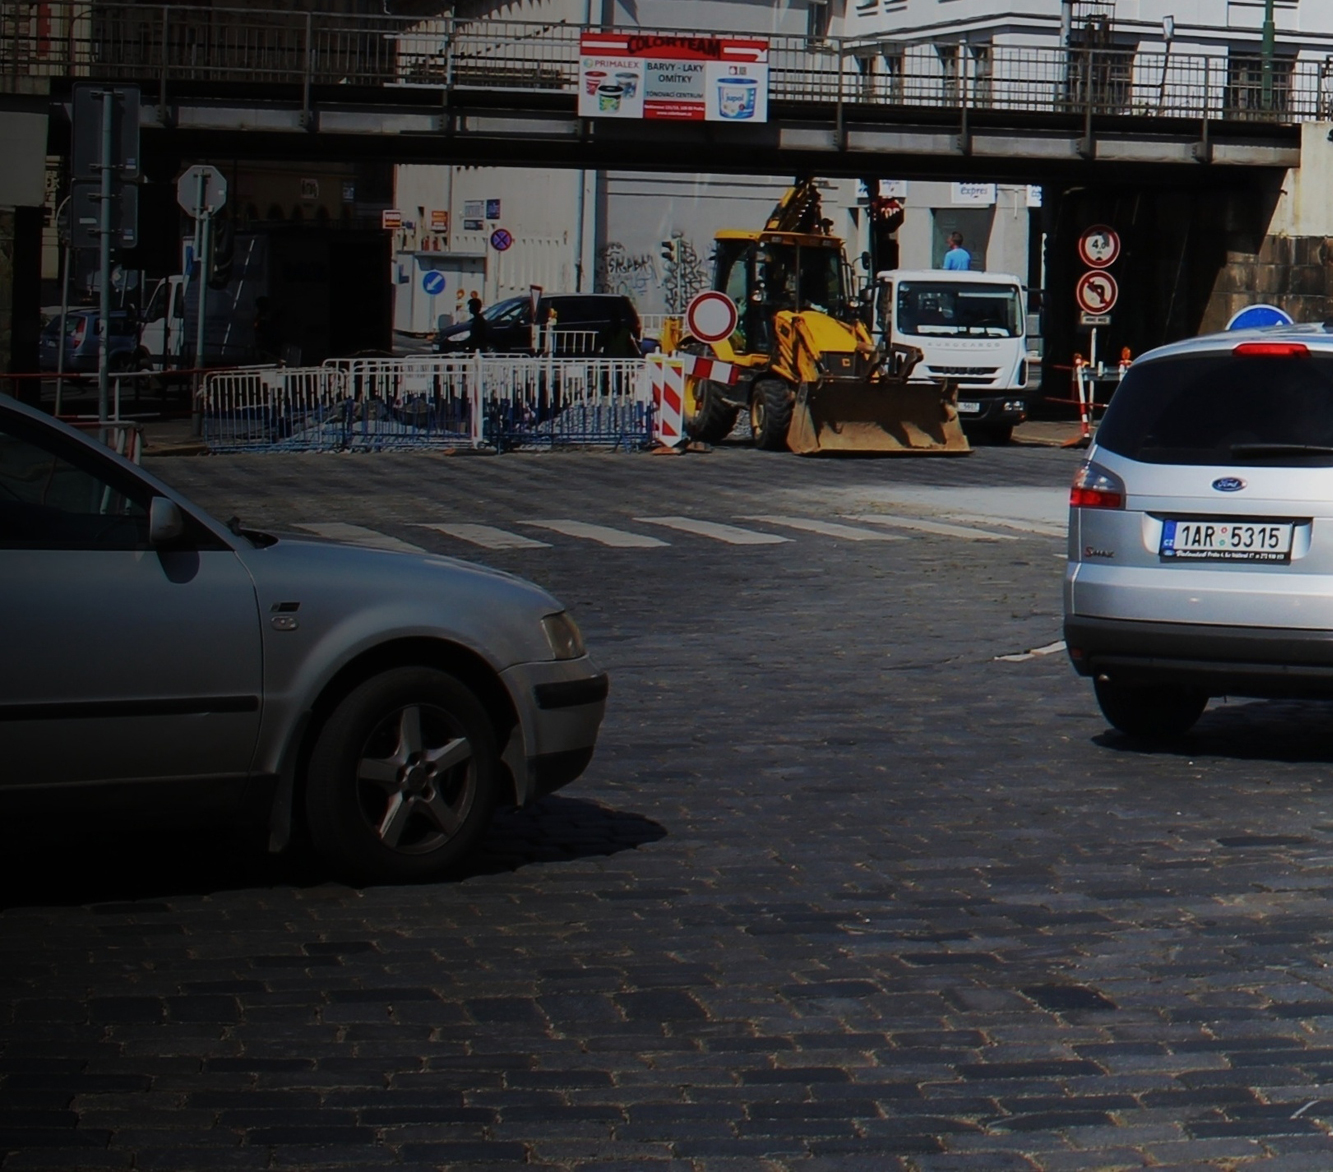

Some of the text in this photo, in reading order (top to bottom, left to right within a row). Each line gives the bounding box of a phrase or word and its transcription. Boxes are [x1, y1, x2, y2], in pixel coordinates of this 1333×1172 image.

[627, 35, 721, 58] COLORTEAM
[594, 59, 639, 69] PRIMALEX
[647, 62, 676, 72] BARVY
[682, 64, 705, 73] LAKY
[658, 72, 693, 84] OMÍTKY
[1182, 526, 1281, 549] 1AR 5315
